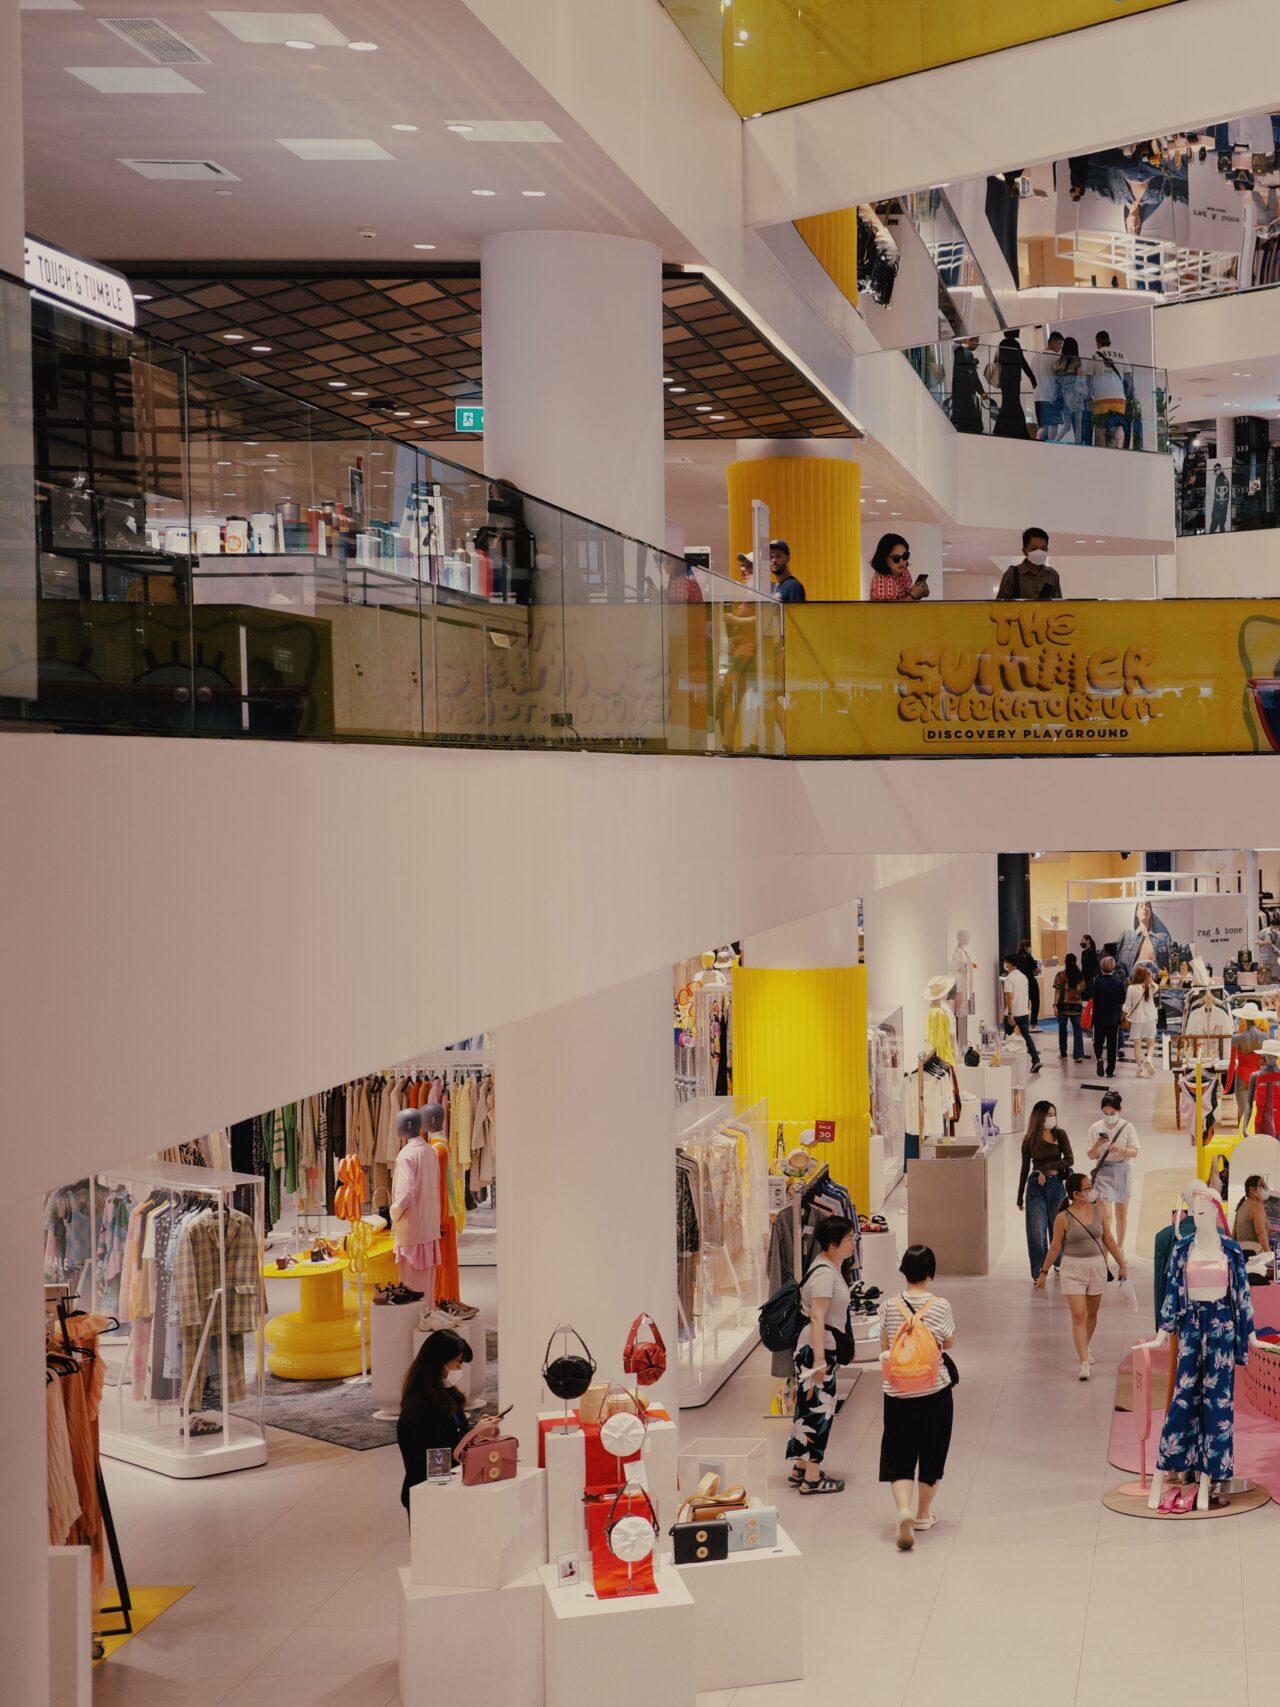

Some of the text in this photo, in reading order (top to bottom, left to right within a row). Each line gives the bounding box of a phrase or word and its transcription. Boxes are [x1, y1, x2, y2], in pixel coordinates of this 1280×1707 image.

[38, 255, 123, 312] TOUGH & TUMBLE
[990, 609, 1076, 648] THE
[896, 644, 1155, 698] SUMMER
[927, 728, 1129, 740] DISCOVERY PLAYGROUND
[1197, 929, 1211, 937] rag
[1214, 927, 1220, 935] &
